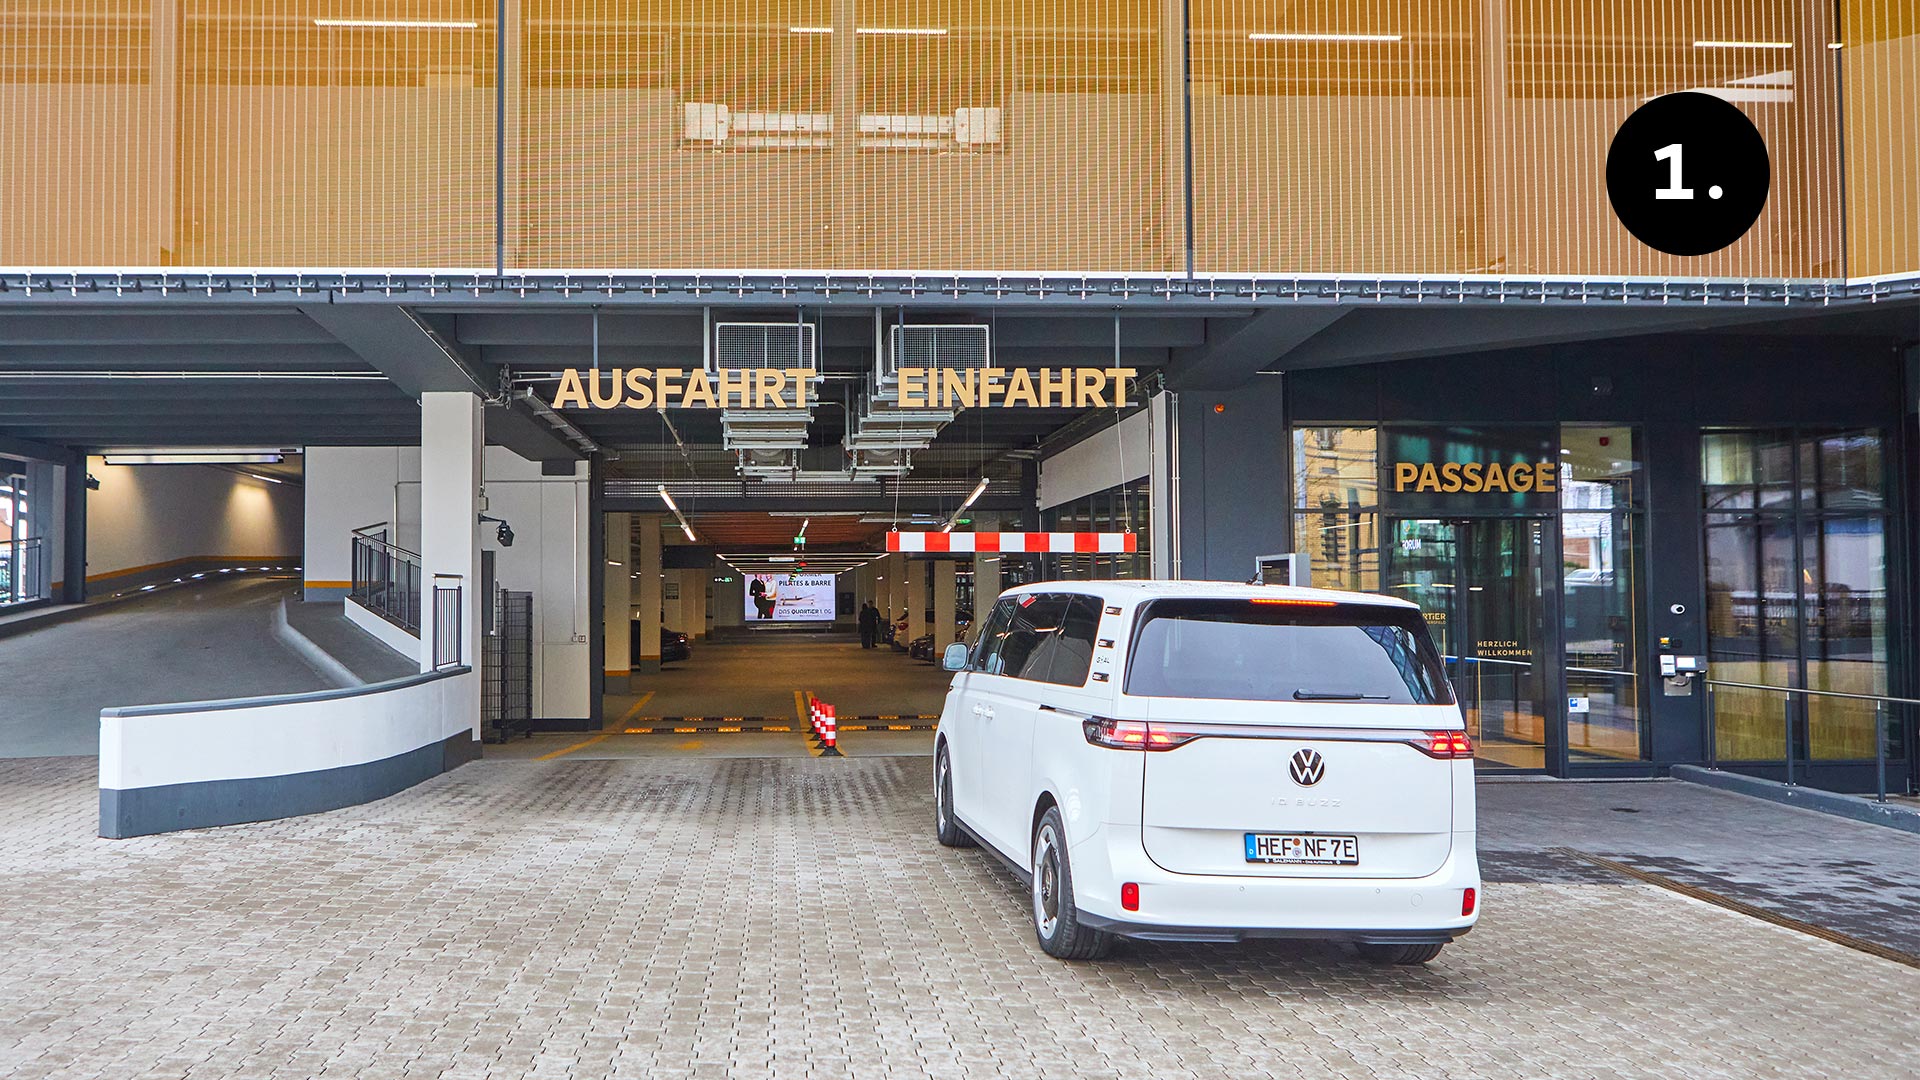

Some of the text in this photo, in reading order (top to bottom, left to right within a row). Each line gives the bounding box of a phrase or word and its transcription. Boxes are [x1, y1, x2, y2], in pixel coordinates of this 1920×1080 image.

[551, 367, 817, 410] AUSFAHRT
[897, 367, 1137, 409] EINFAHRT
[1395, 462, 1556, 493] PASSAGE
[1477, 640, 1518, 648] HERZLICH
[1477, 649, 1533, 657] WILLKOMMEN
[1296, 797, 1342, 808] BUZZ
[1257, 837, 1293, 857] HEF
[1304, 838, 1327, 857] NF
[1331, 839, 1355, 858] 7E
